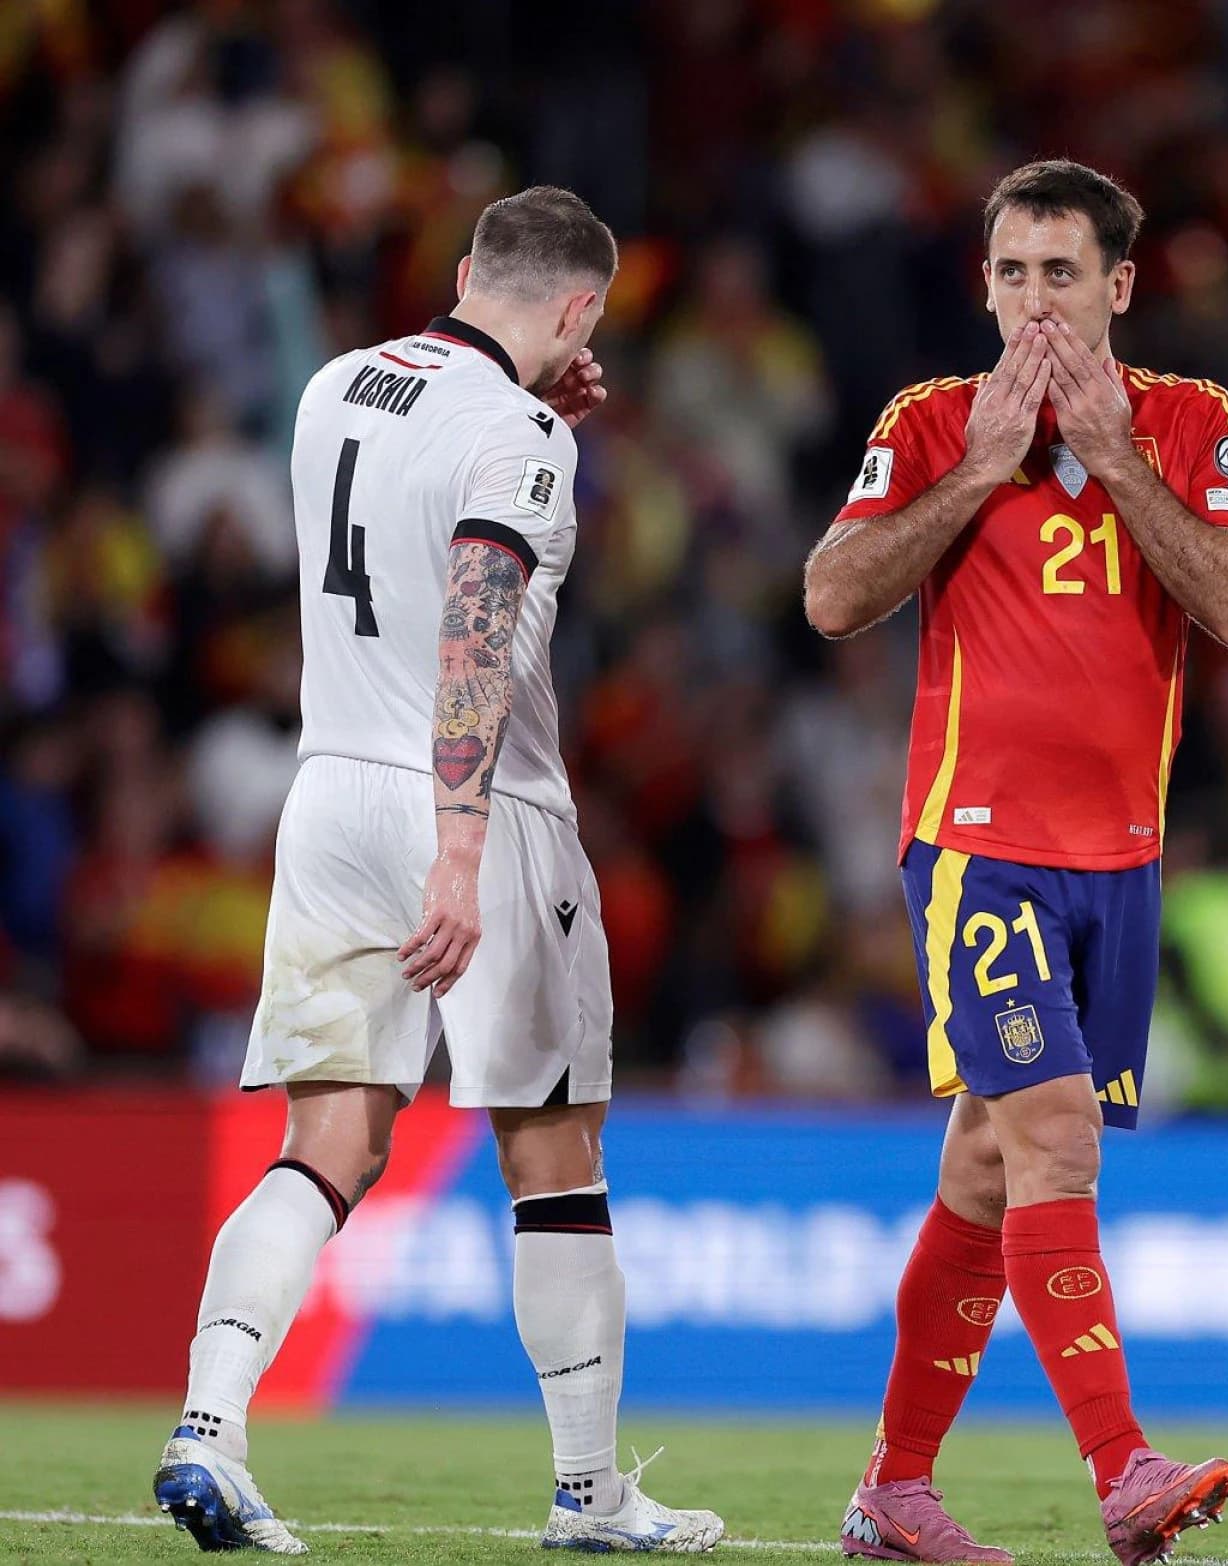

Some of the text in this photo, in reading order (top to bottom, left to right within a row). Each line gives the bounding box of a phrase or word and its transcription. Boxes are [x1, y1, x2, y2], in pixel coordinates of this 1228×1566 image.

[342, 364, 428, 417] KASHIA
[322, 437, 380, 638] 4
[1039, 512, 1122, 595] 21
[962, 900, 1052, 997] 21
